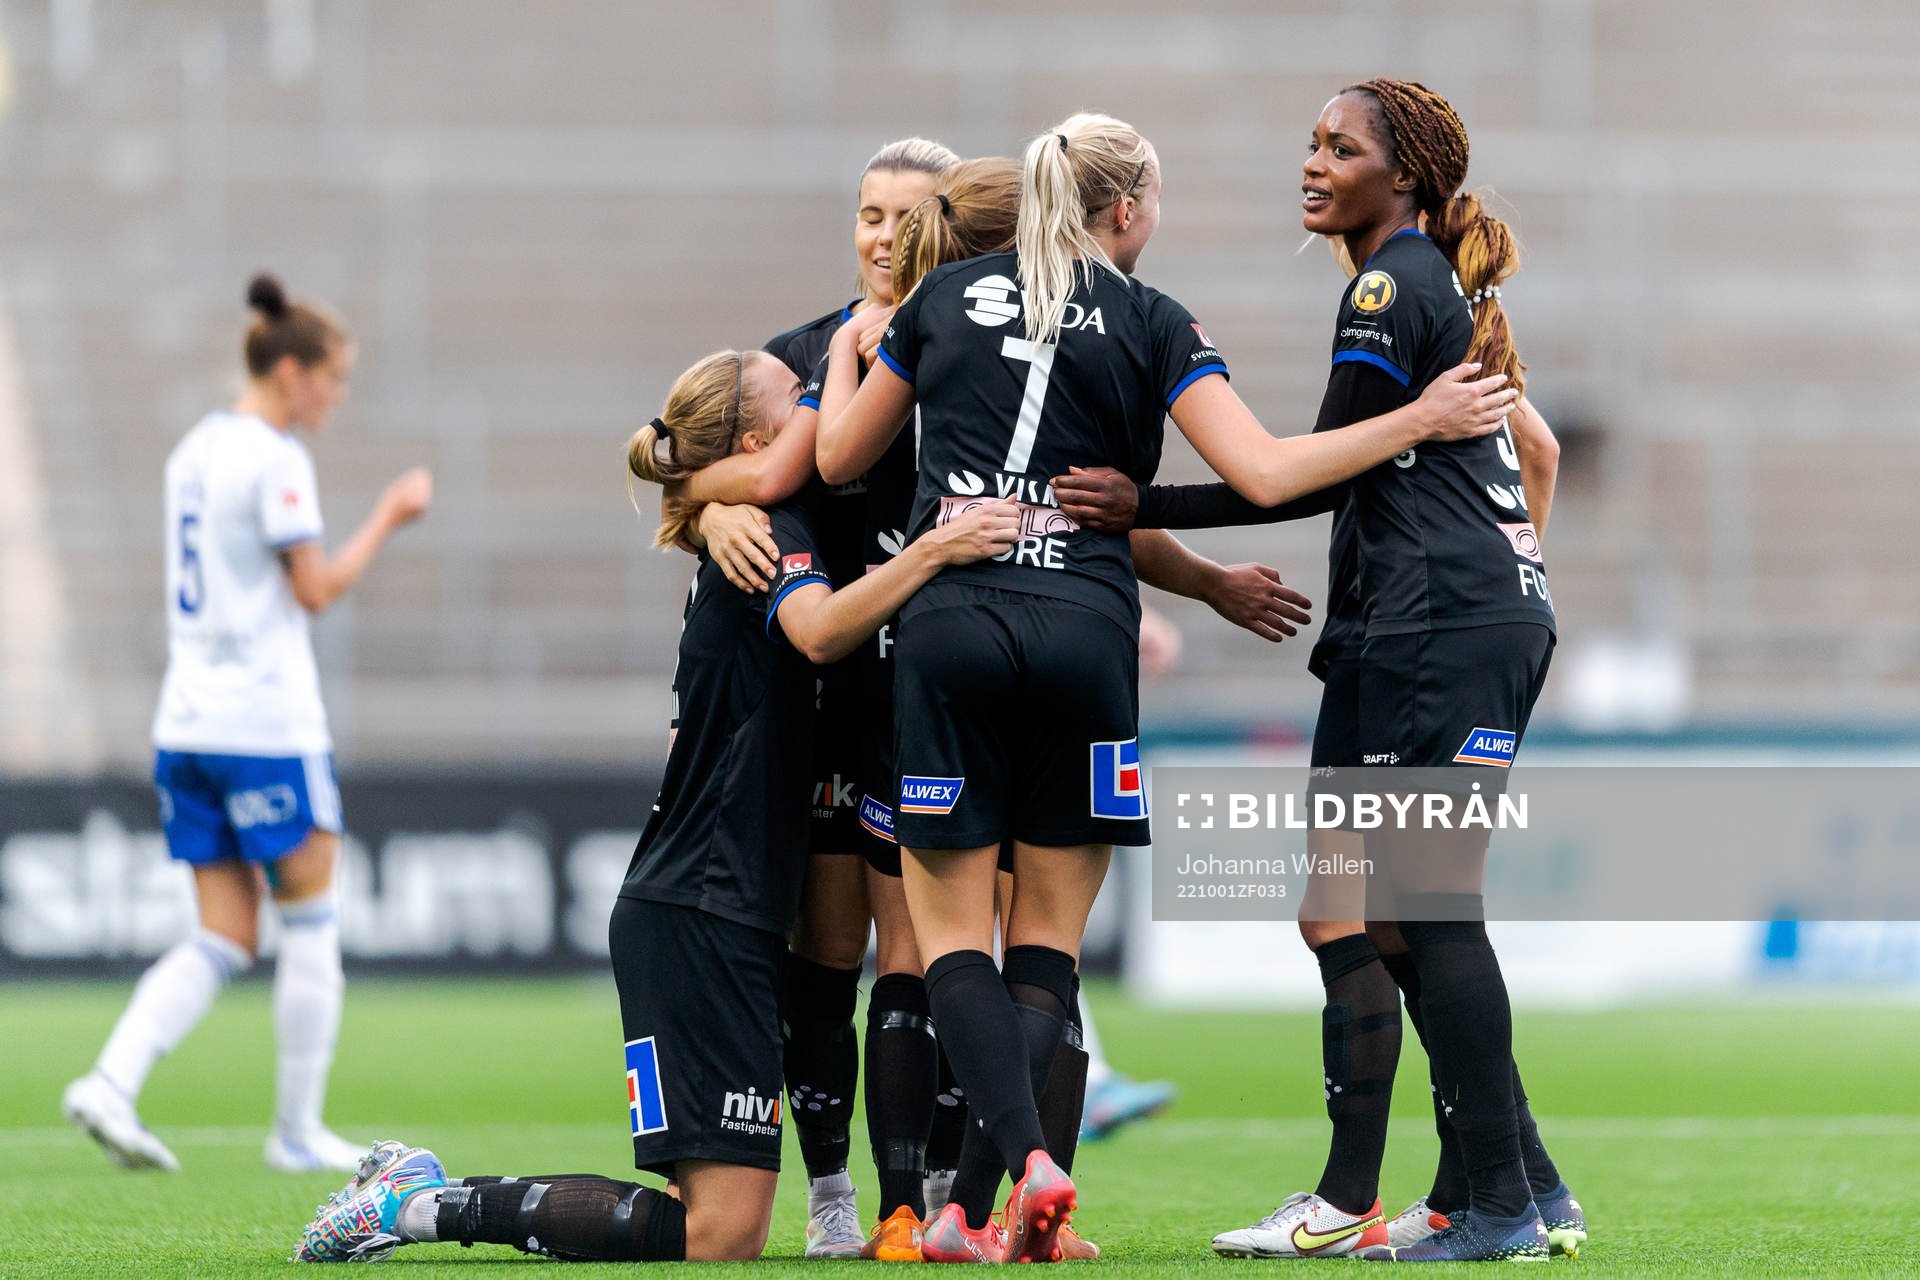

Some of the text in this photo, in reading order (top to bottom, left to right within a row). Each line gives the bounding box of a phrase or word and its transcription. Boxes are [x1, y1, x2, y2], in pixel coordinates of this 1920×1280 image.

[1001, 336, 1055, 473] 7
[178, 514, 204, 617] 5
[1363, 754, 1390, 765] CRAFT
[902, 784, 951, 800] ALWEX
[720, 1118, 779, 1136] Fastigheter
